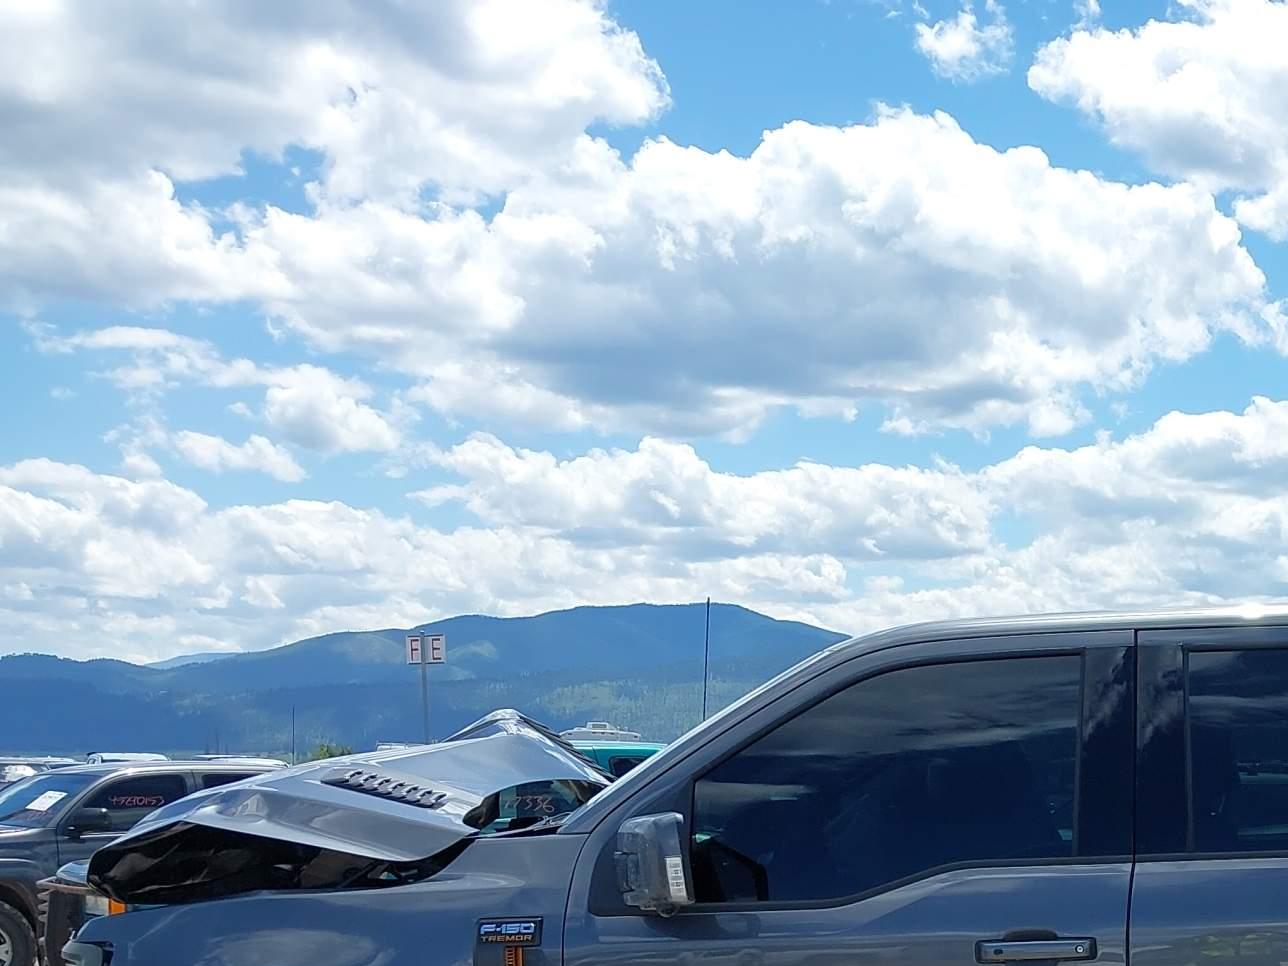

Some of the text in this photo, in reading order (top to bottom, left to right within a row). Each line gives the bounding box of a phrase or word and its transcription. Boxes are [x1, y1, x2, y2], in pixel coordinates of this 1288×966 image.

[410, 637, 442, 661] F E
[480, 923, 535, 935] F-150
[480, 934, 533, 942] TREMOR
